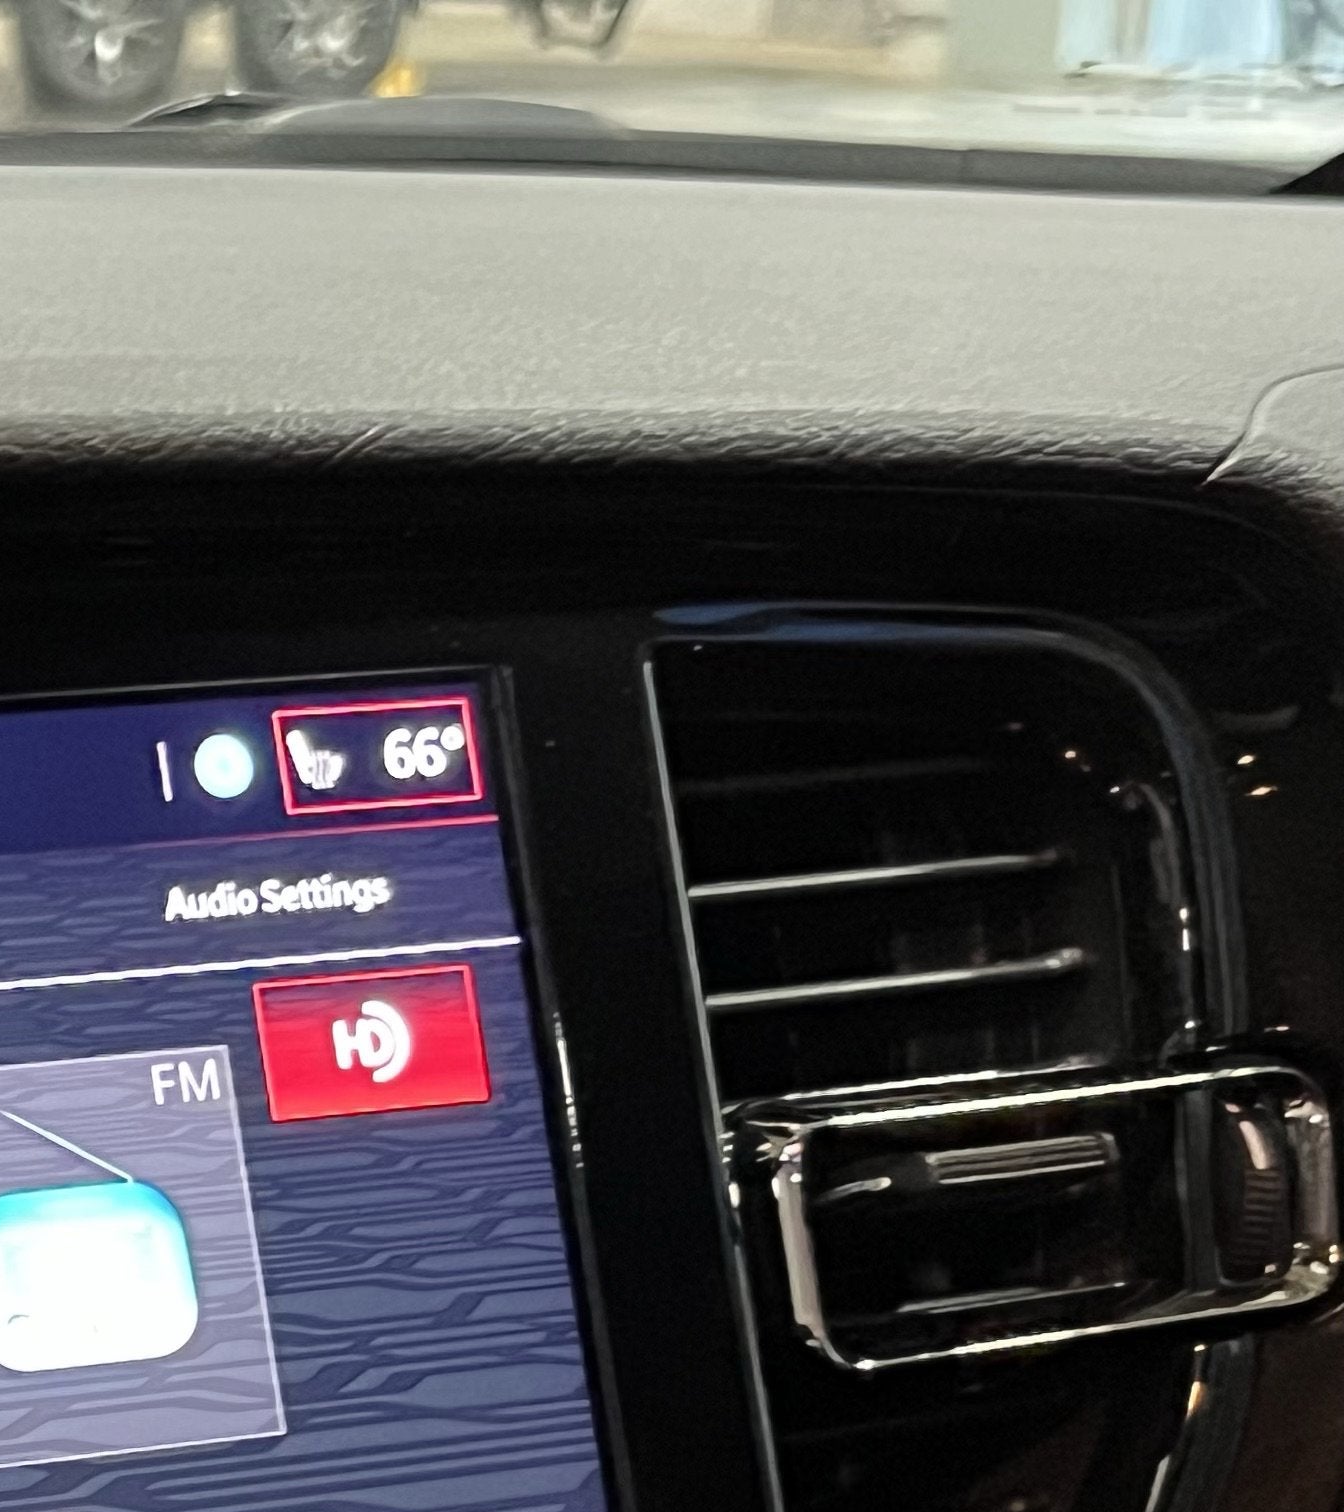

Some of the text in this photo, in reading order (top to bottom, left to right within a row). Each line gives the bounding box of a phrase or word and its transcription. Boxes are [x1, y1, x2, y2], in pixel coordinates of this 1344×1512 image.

[383, 724, 465, 780] 66°
[164, 872, 392, 922] Audio Settings
[149, 1060, 222, 1106] FM
